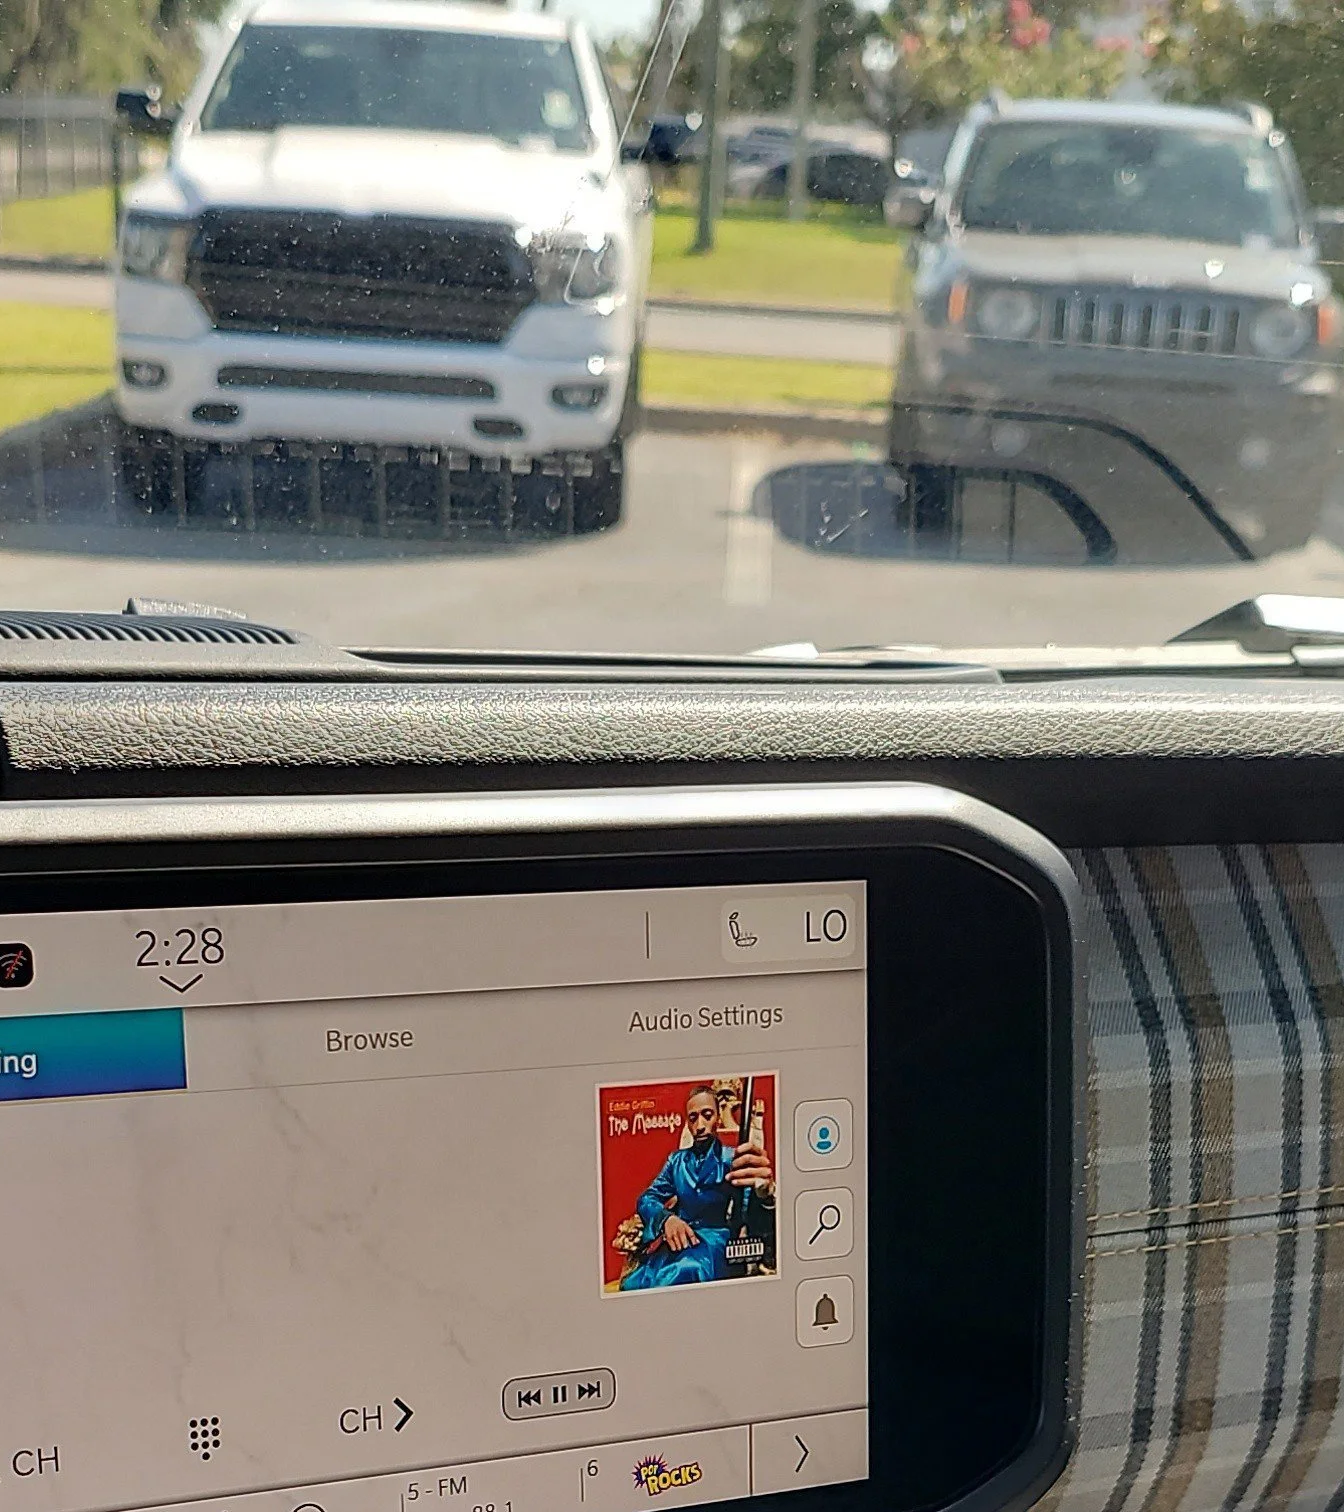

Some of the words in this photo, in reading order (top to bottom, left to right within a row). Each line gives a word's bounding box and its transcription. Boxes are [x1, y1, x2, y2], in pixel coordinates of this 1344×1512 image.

[805, 909, 848, 944] LO
[135, 928, 225, 967] 2:28
[629, 1007, 693, 1033] Audio
[698, 1004, 783, 1034] Settings
[326, 1027, 414, 1053] Browse
[339, 1405, 384, 1435] CH
[11, 1447, 61, 1478] CH
[587, 1460, 599, 1478] 6
[407, 1482, 420, 1501] 5
[437, 1476, 469, 1499] FM
[647, 1463, 703, 1495] ROCKS
